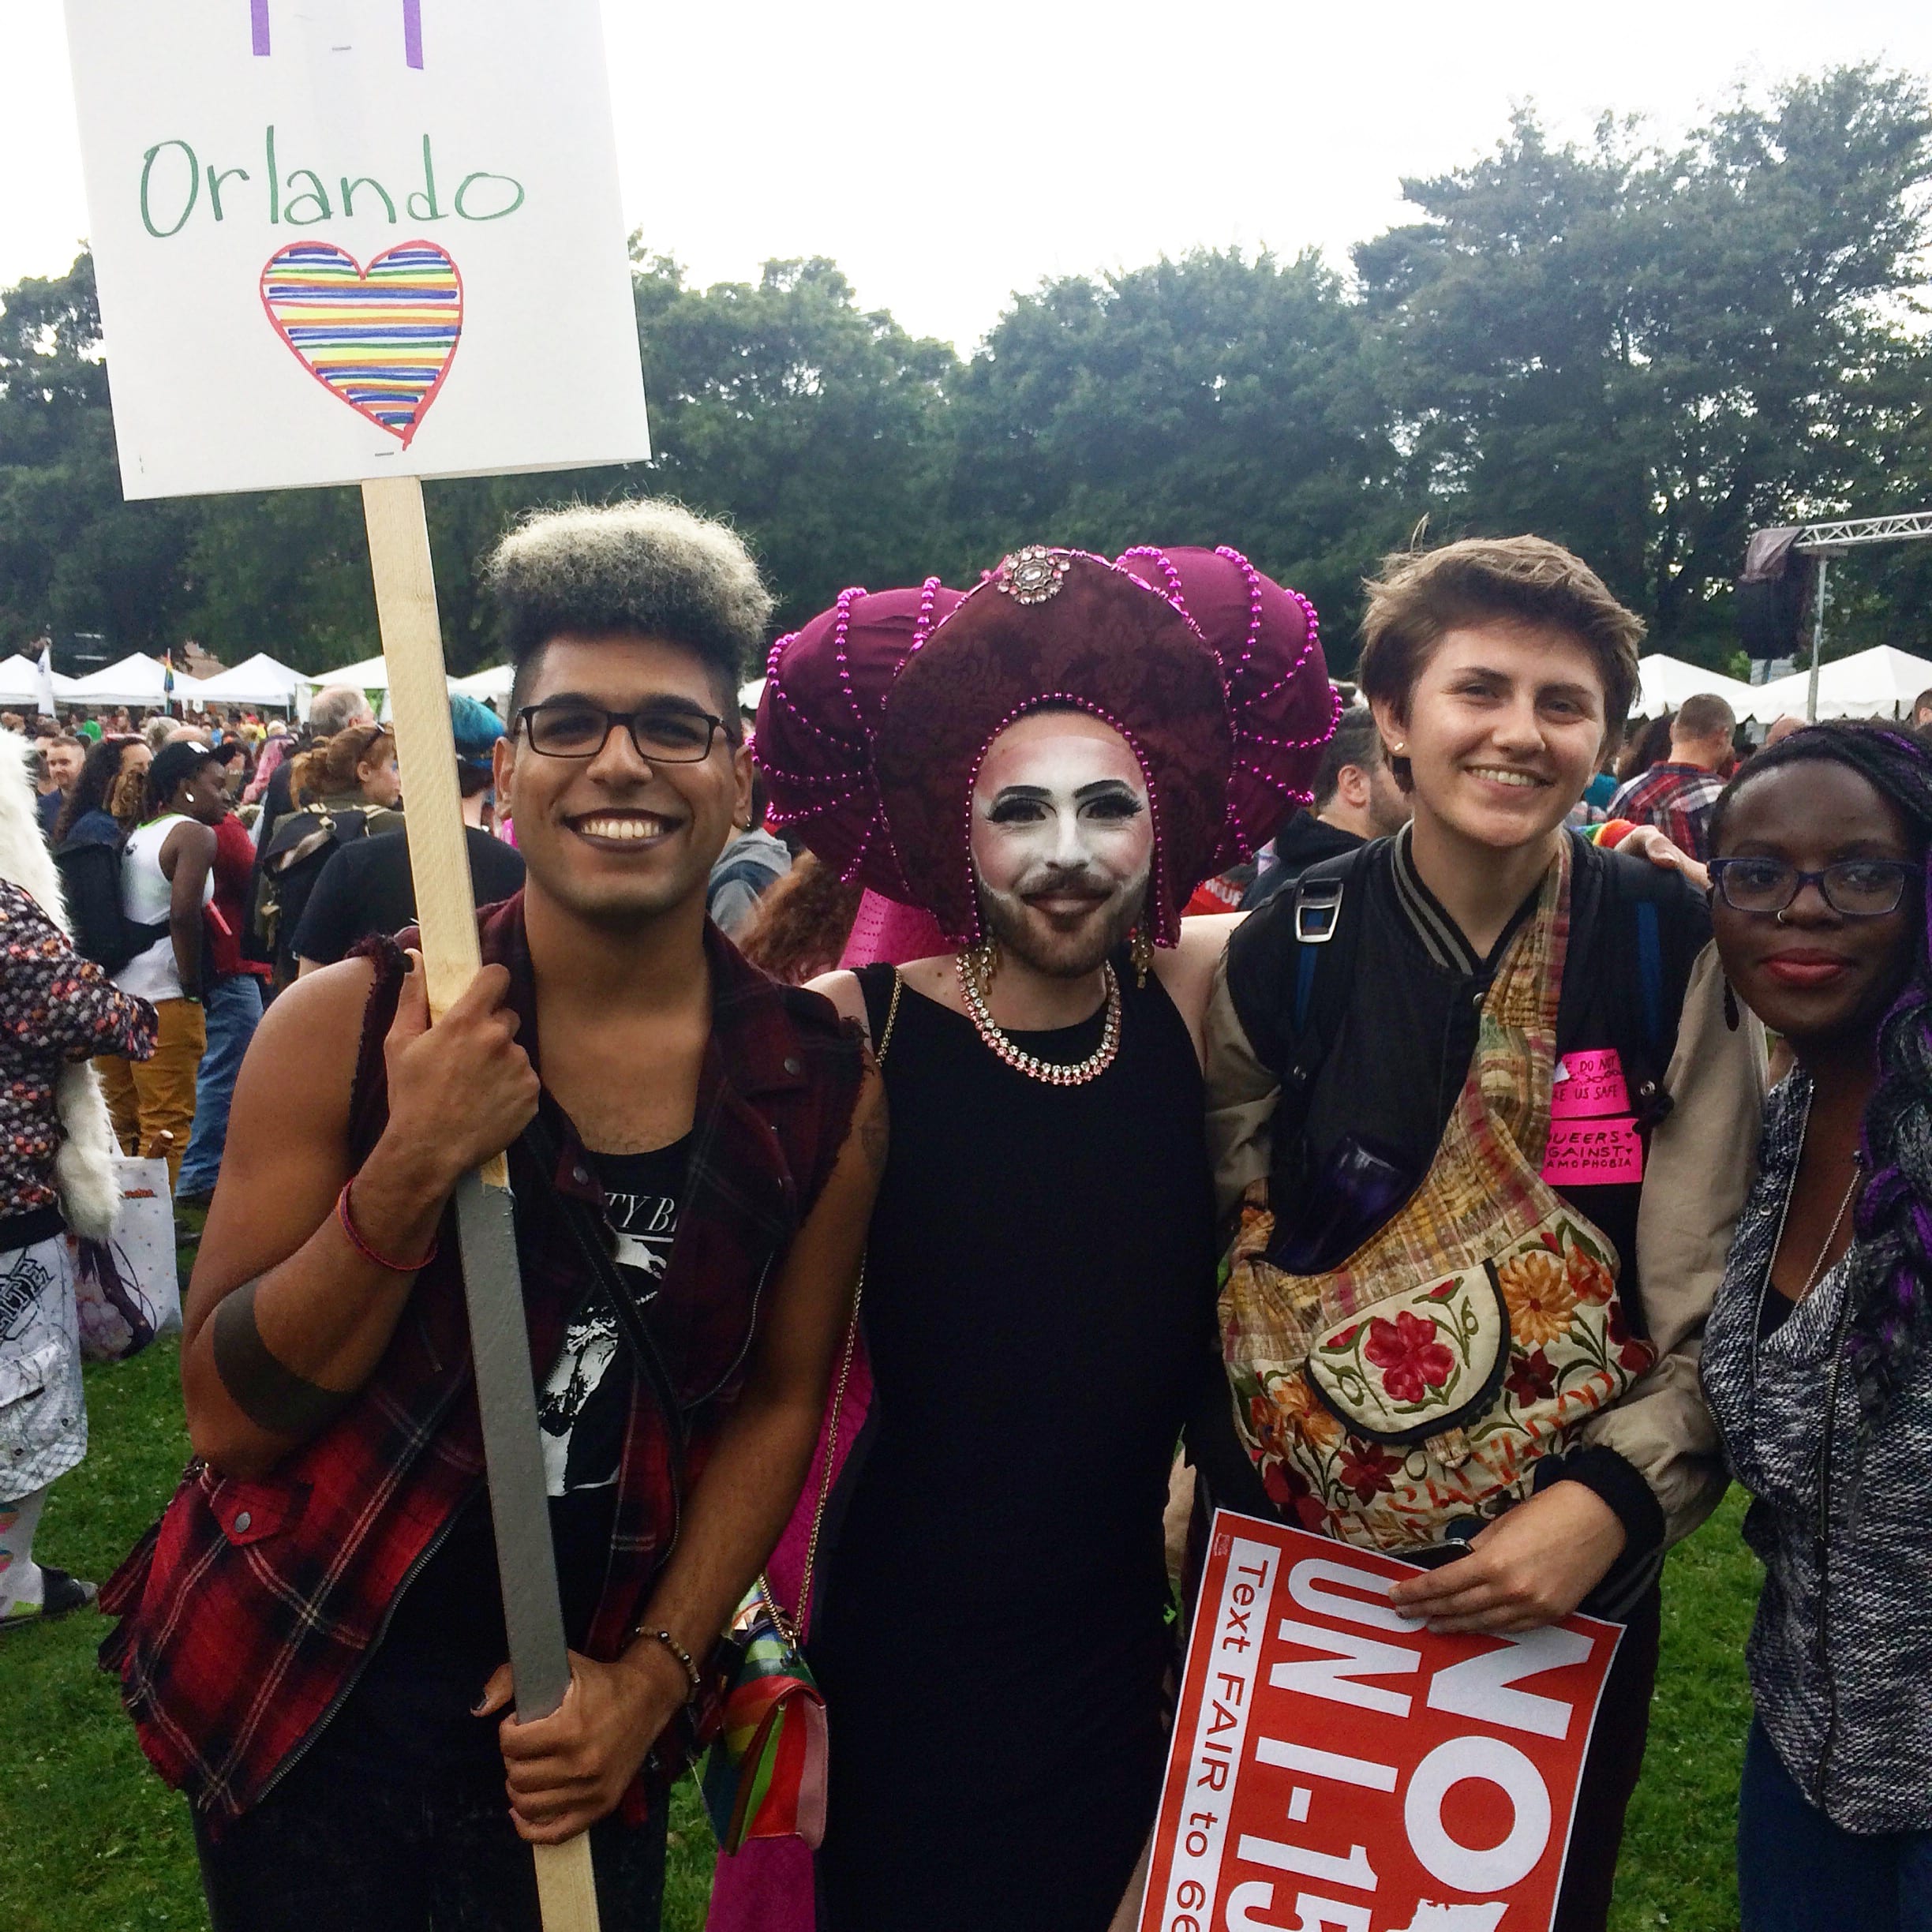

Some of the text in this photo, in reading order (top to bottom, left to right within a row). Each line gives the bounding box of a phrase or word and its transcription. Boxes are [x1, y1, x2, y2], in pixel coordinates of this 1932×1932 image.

[140, 125, 525, 238] Orlando
[1579, 1060, 1594, 1073] DO
[1574, 1087, 1589, 1099] US
[1593, 1084, 1618, 1100] SAFE
[1547, 1158, 1631, 1168] AMOPHOBIA
[1548, 1145, 1625, 1158] GAINST
[605, 1192, 652, 1229] TY
[1222, 1559, 1269, 1653] Text
[1197, 1672, 1246, 1792] FAIR
[1404, 1623, 1596, 1893] NO
[1185, 1811, 1219, 1858] to
